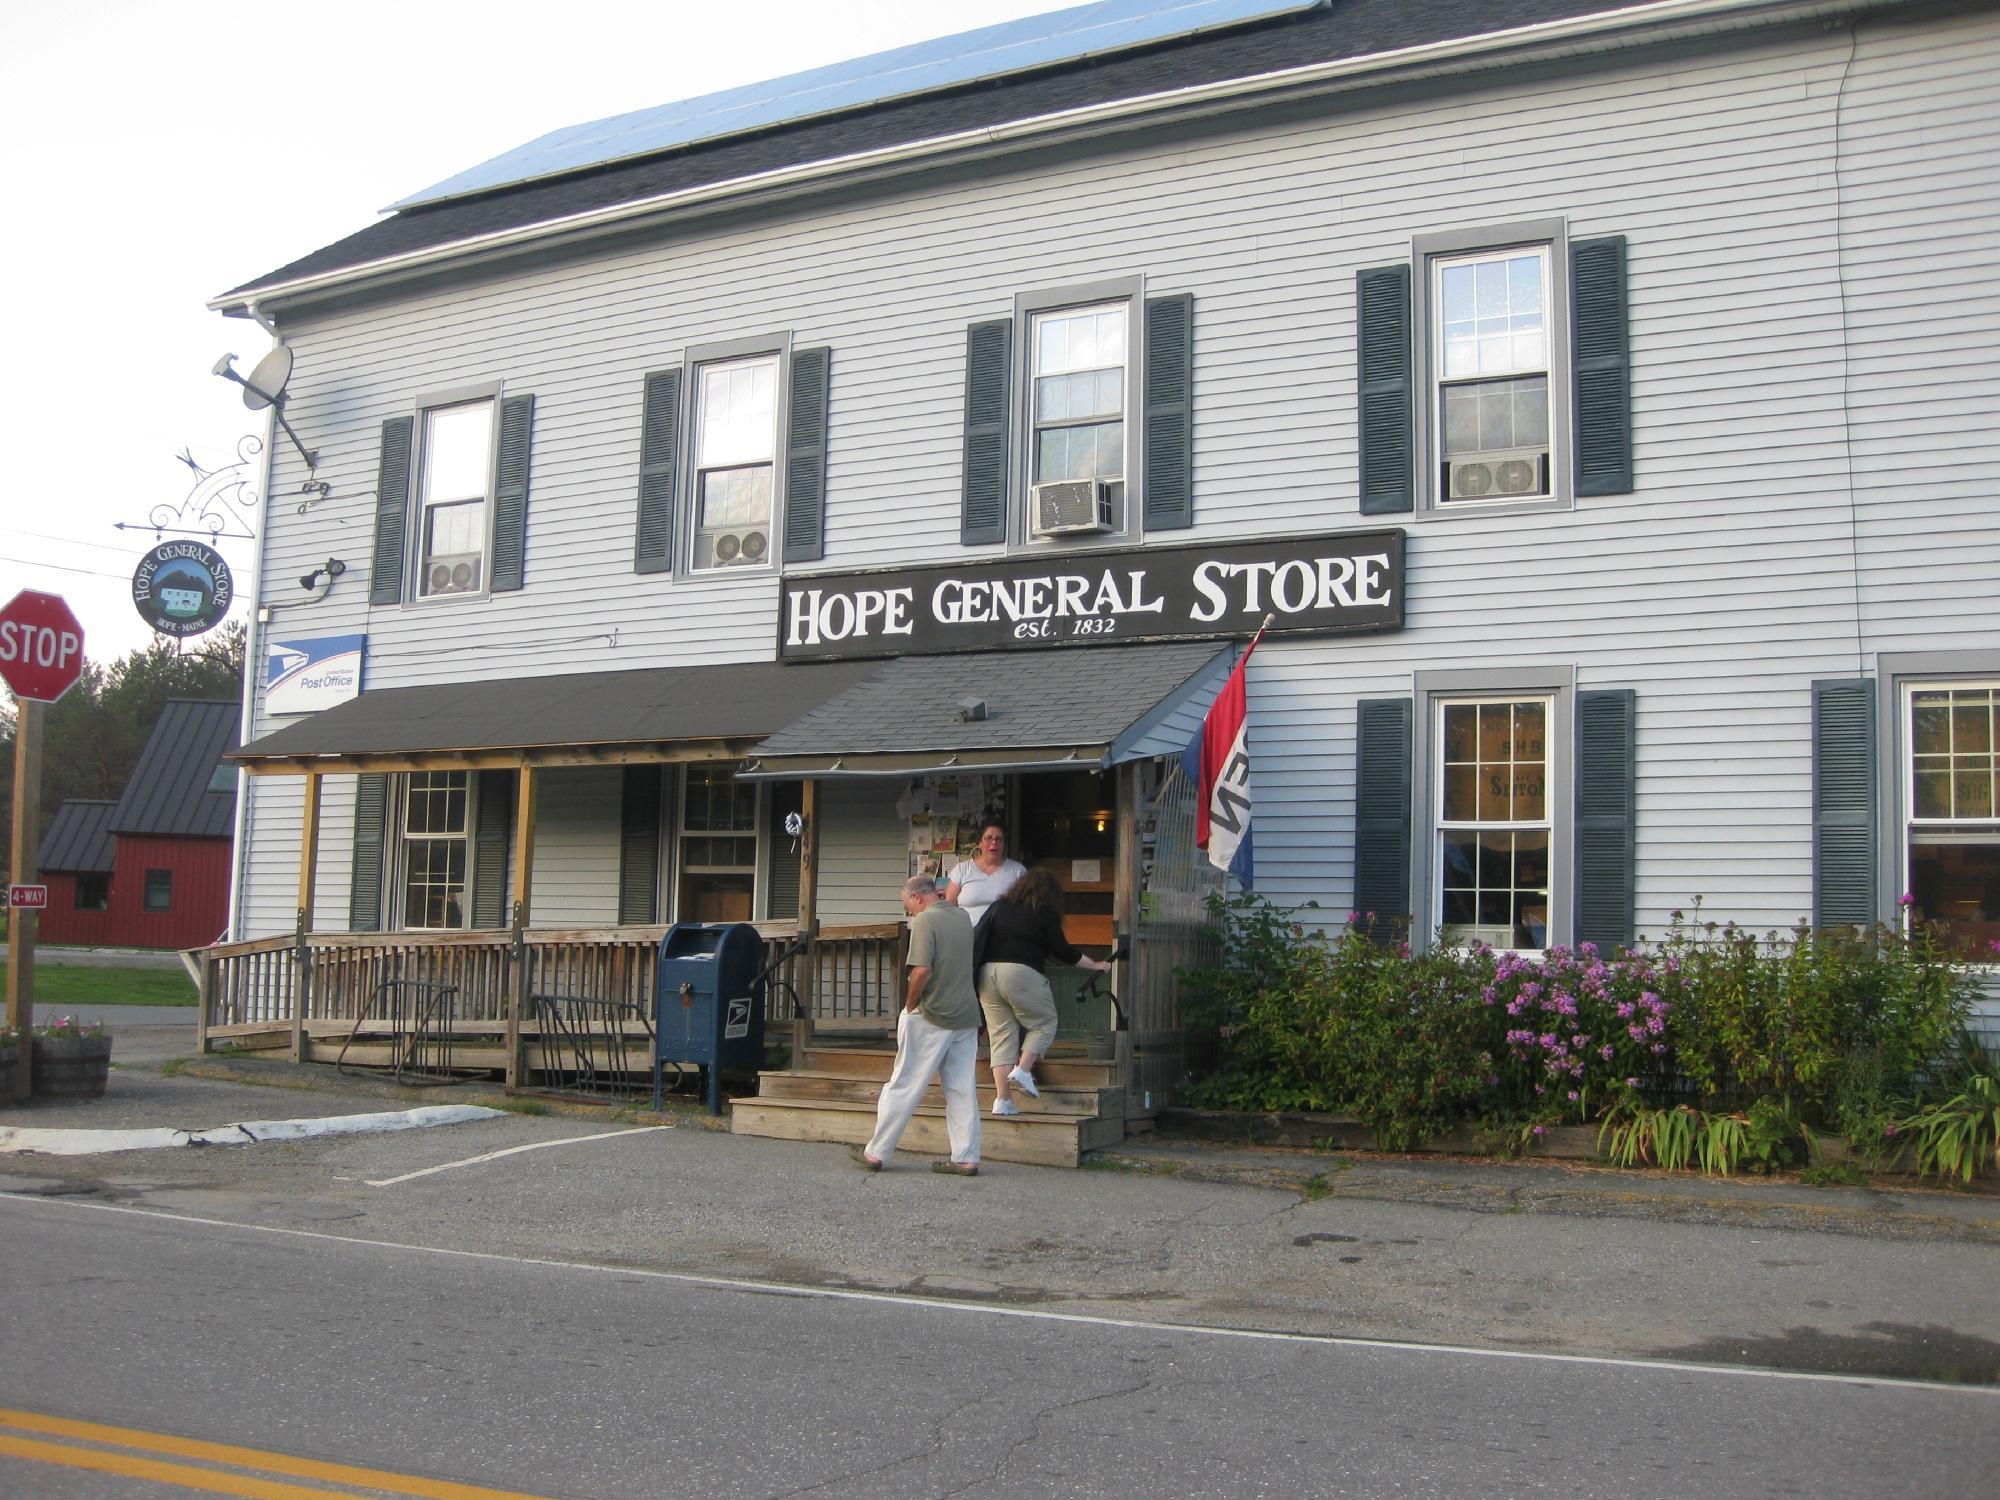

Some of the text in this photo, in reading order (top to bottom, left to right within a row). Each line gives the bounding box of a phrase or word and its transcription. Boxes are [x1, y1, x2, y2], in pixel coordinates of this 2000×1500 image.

[134, 544, 229, 608] HOPE GENERAL STORE
[787, 553, 1391, 645] HOPE GENERAL STORE
[182, 618, 208, 632] MAINE
[1014, 618, 1115, 639] est. 1832
[0, 620, 79, 669] STOP
[300, 675, 353, 689] Post Office
[12, 889, 44, 903] 4-WAY
